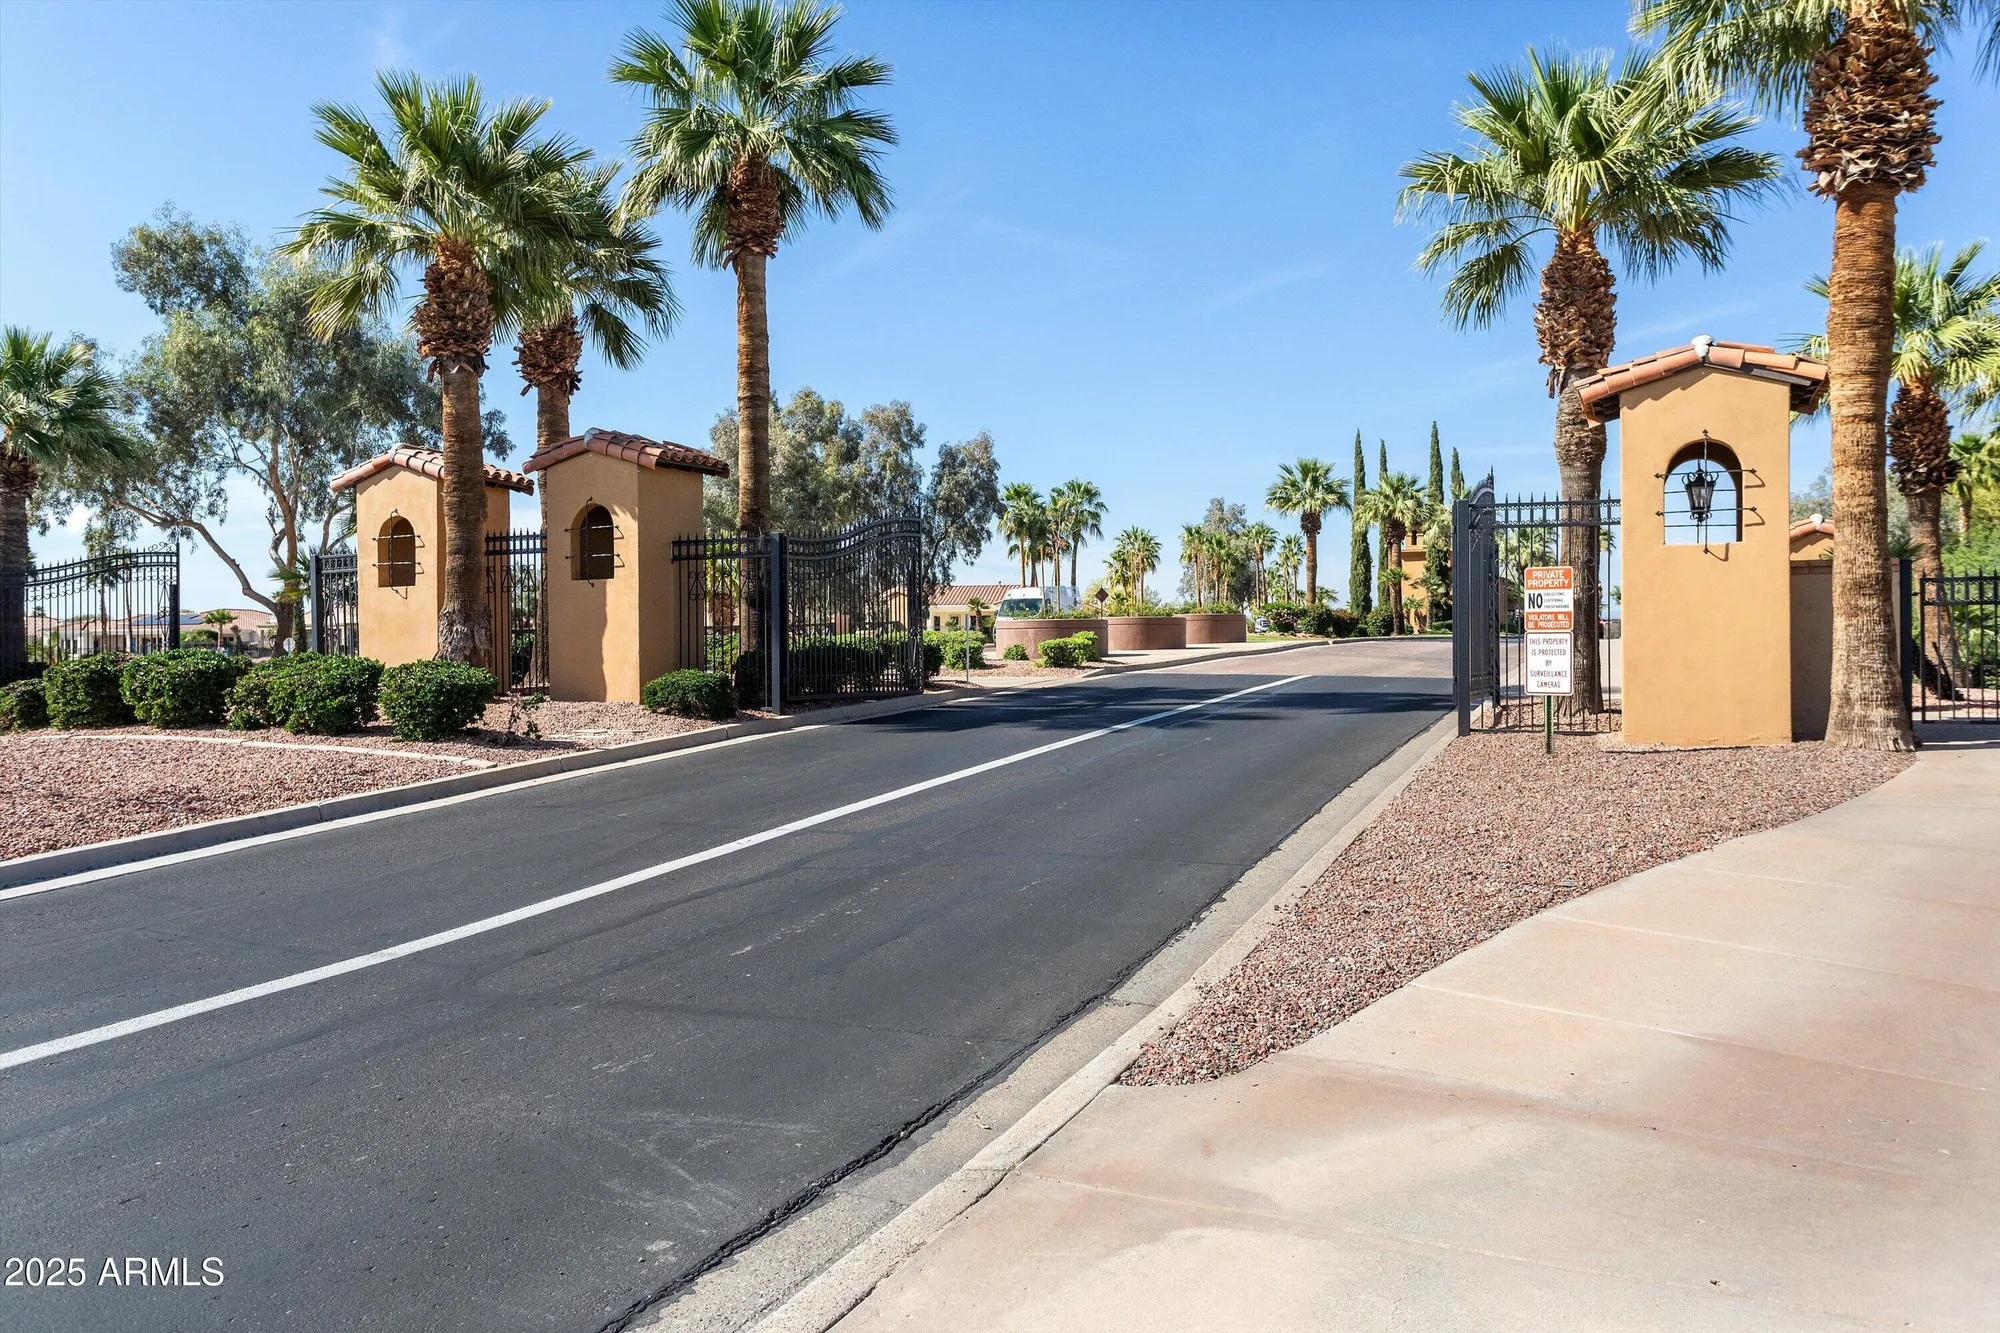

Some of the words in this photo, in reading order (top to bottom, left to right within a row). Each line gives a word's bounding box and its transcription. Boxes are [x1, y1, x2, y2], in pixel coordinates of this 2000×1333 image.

[1532, 570, 1564, 579] PRIVATE
[1528, 578, 1569, 588] PROPERTY
[1528, 593, 1543, 609] NO
[1557, 613, 1569, 621] WILL
